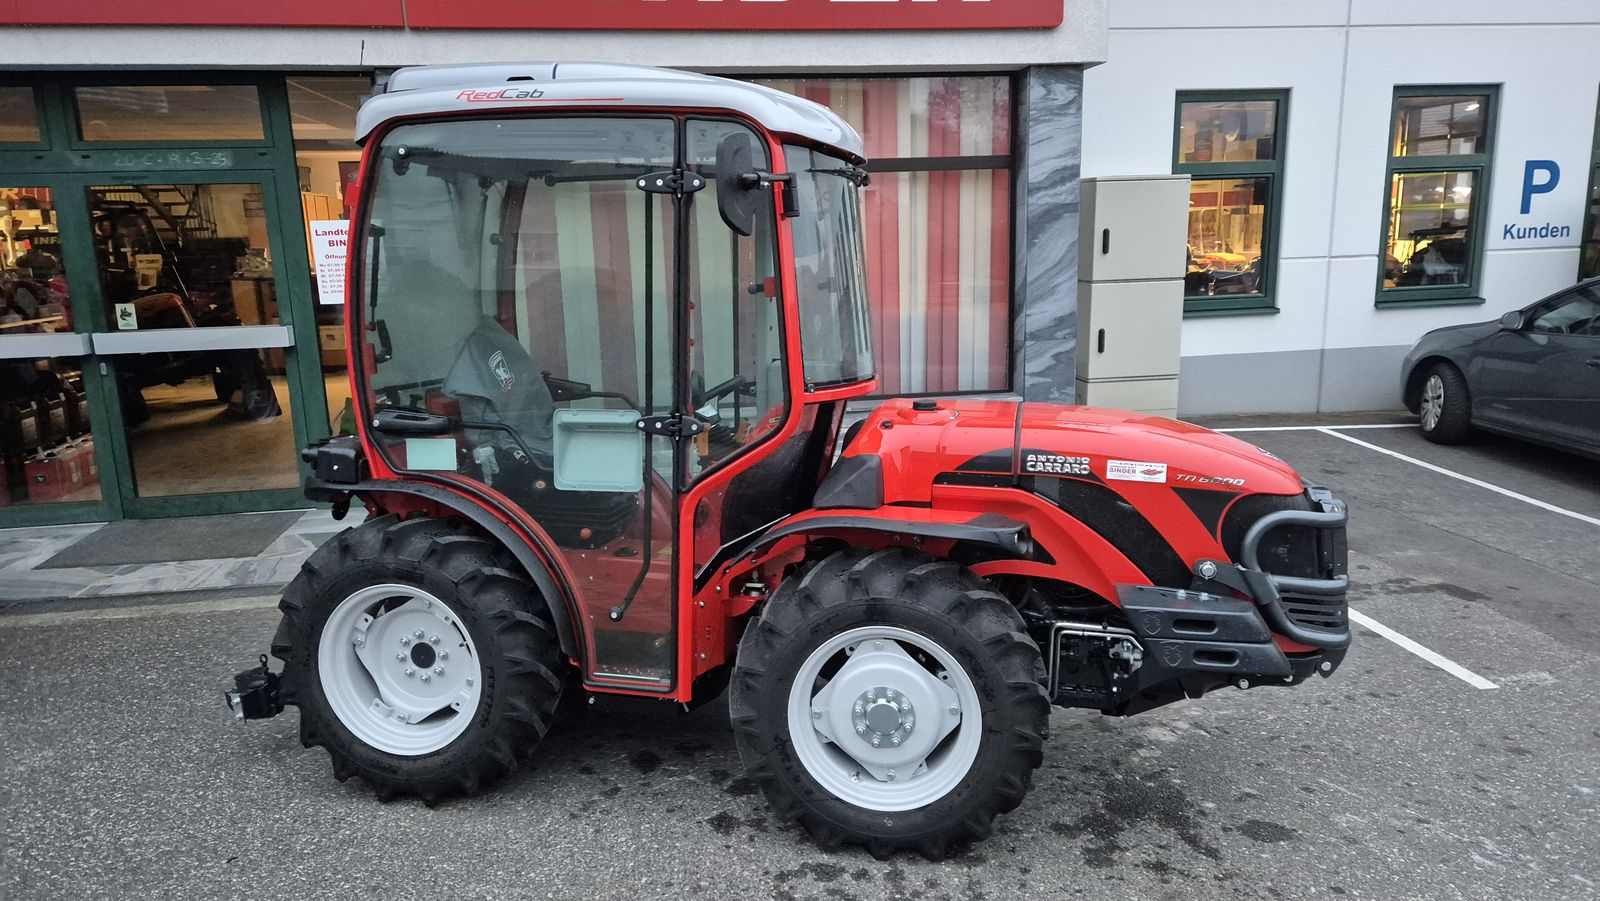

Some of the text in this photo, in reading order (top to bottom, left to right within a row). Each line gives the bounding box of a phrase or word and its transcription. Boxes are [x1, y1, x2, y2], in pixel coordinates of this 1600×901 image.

[456, 89, 544, 101] RedCab
[1520, 160, 1561, 214] P
[1503, 222, 1570, 240] Kunden
[1027, 454, 1091, 465] ANTONIO
[1026, 461, 1091, 475] CARRARO
[1109, 467, 1137, 475] BINDER
